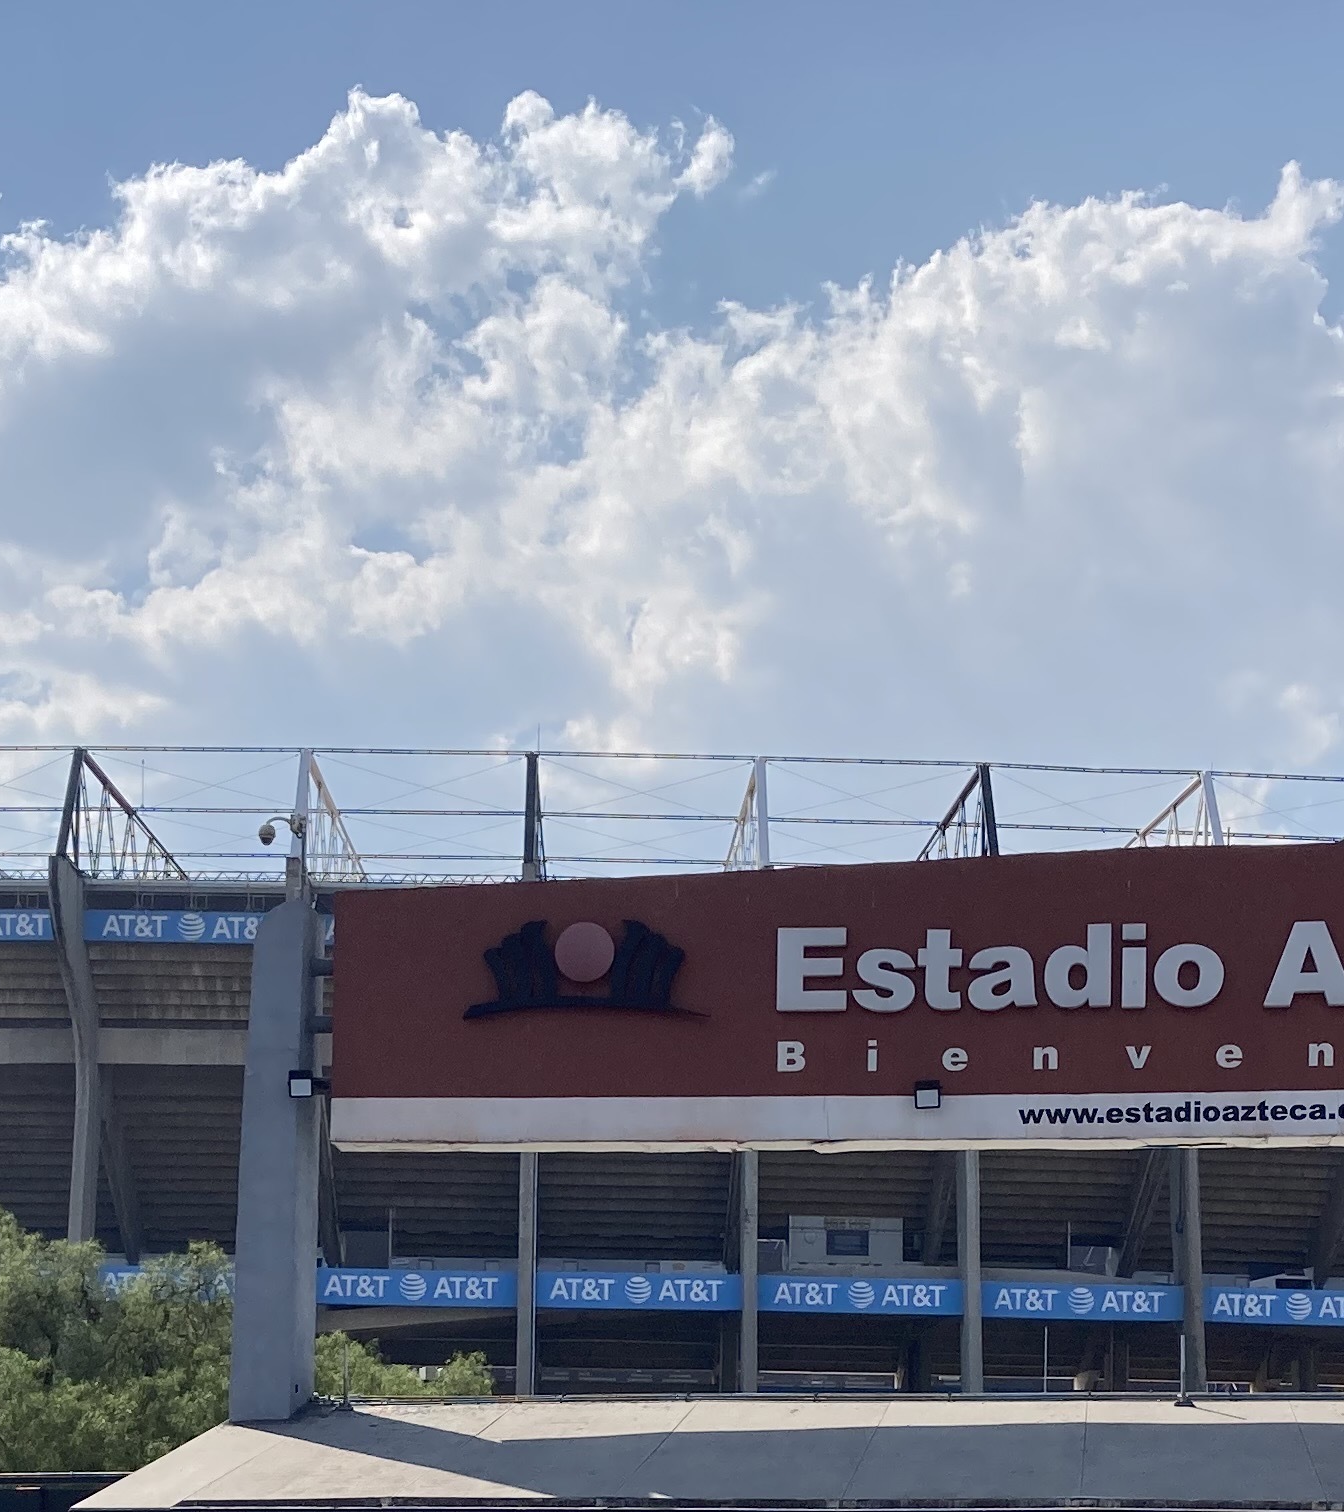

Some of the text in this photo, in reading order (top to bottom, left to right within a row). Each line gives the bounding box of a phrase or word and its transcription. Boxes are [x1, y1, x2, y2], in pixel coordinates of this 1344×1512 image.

[102, 914, 258, 940] AT&T AT&
[776, 923, 1225, 1013] Estadio
[324, 1274, 498, 1300] AT&T AT&T
[550, 1277, 723, 1302] AT&T AT&T
[774, 1282, 945, 1307] AT&T AT&T
[995, 1288, 1166, 1313] AT&T AT&T
[1213, 1293, 1277, 1317] AT&T
